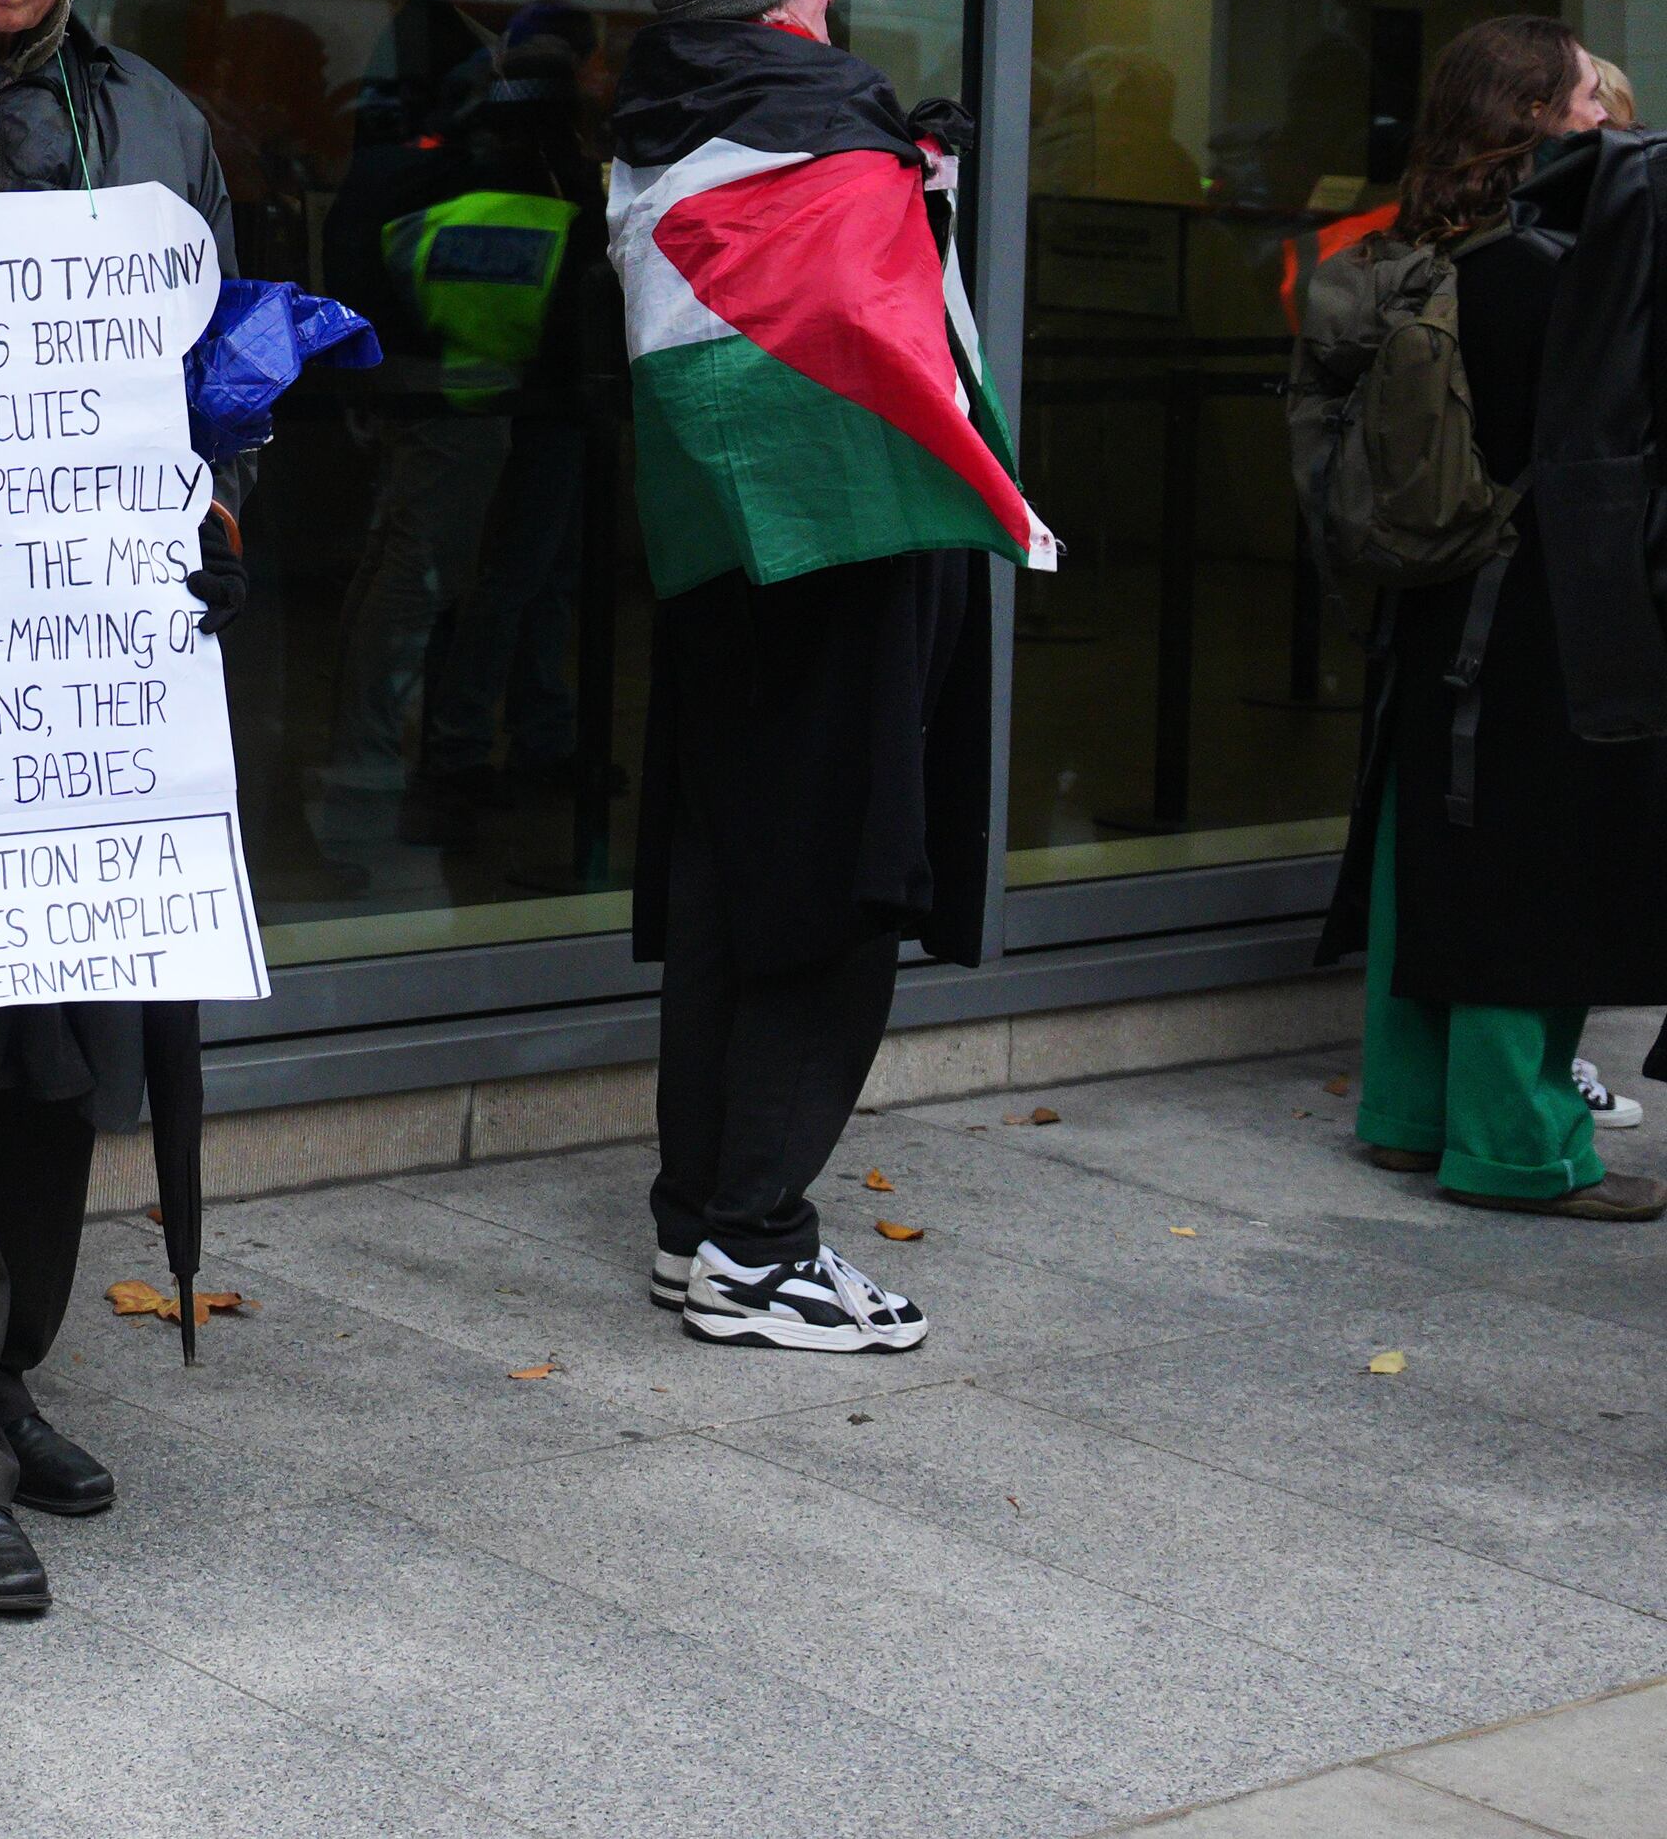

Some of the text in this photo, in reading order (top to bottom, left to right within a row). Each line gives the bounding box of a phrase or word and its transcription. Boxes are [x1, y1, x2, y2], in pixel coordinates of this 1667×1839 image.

[51, 239, 205, 300] TYRANNY
[32, 316, 162, 365] BRITAIN
[15, 538, 92, 589] THE
[107, 538, 188, 586] MASS
[7, 610, 156, 669] MAIMING
[170, 609, 207, 654] OF
[62, 680, 166, 728] THEIR
[13, 748, 156, 803] BABIES
[96, 835, 142, 881] BY
[159, 833, 182, 875] A
[47, 889, 225, 944] COMPLICIT
